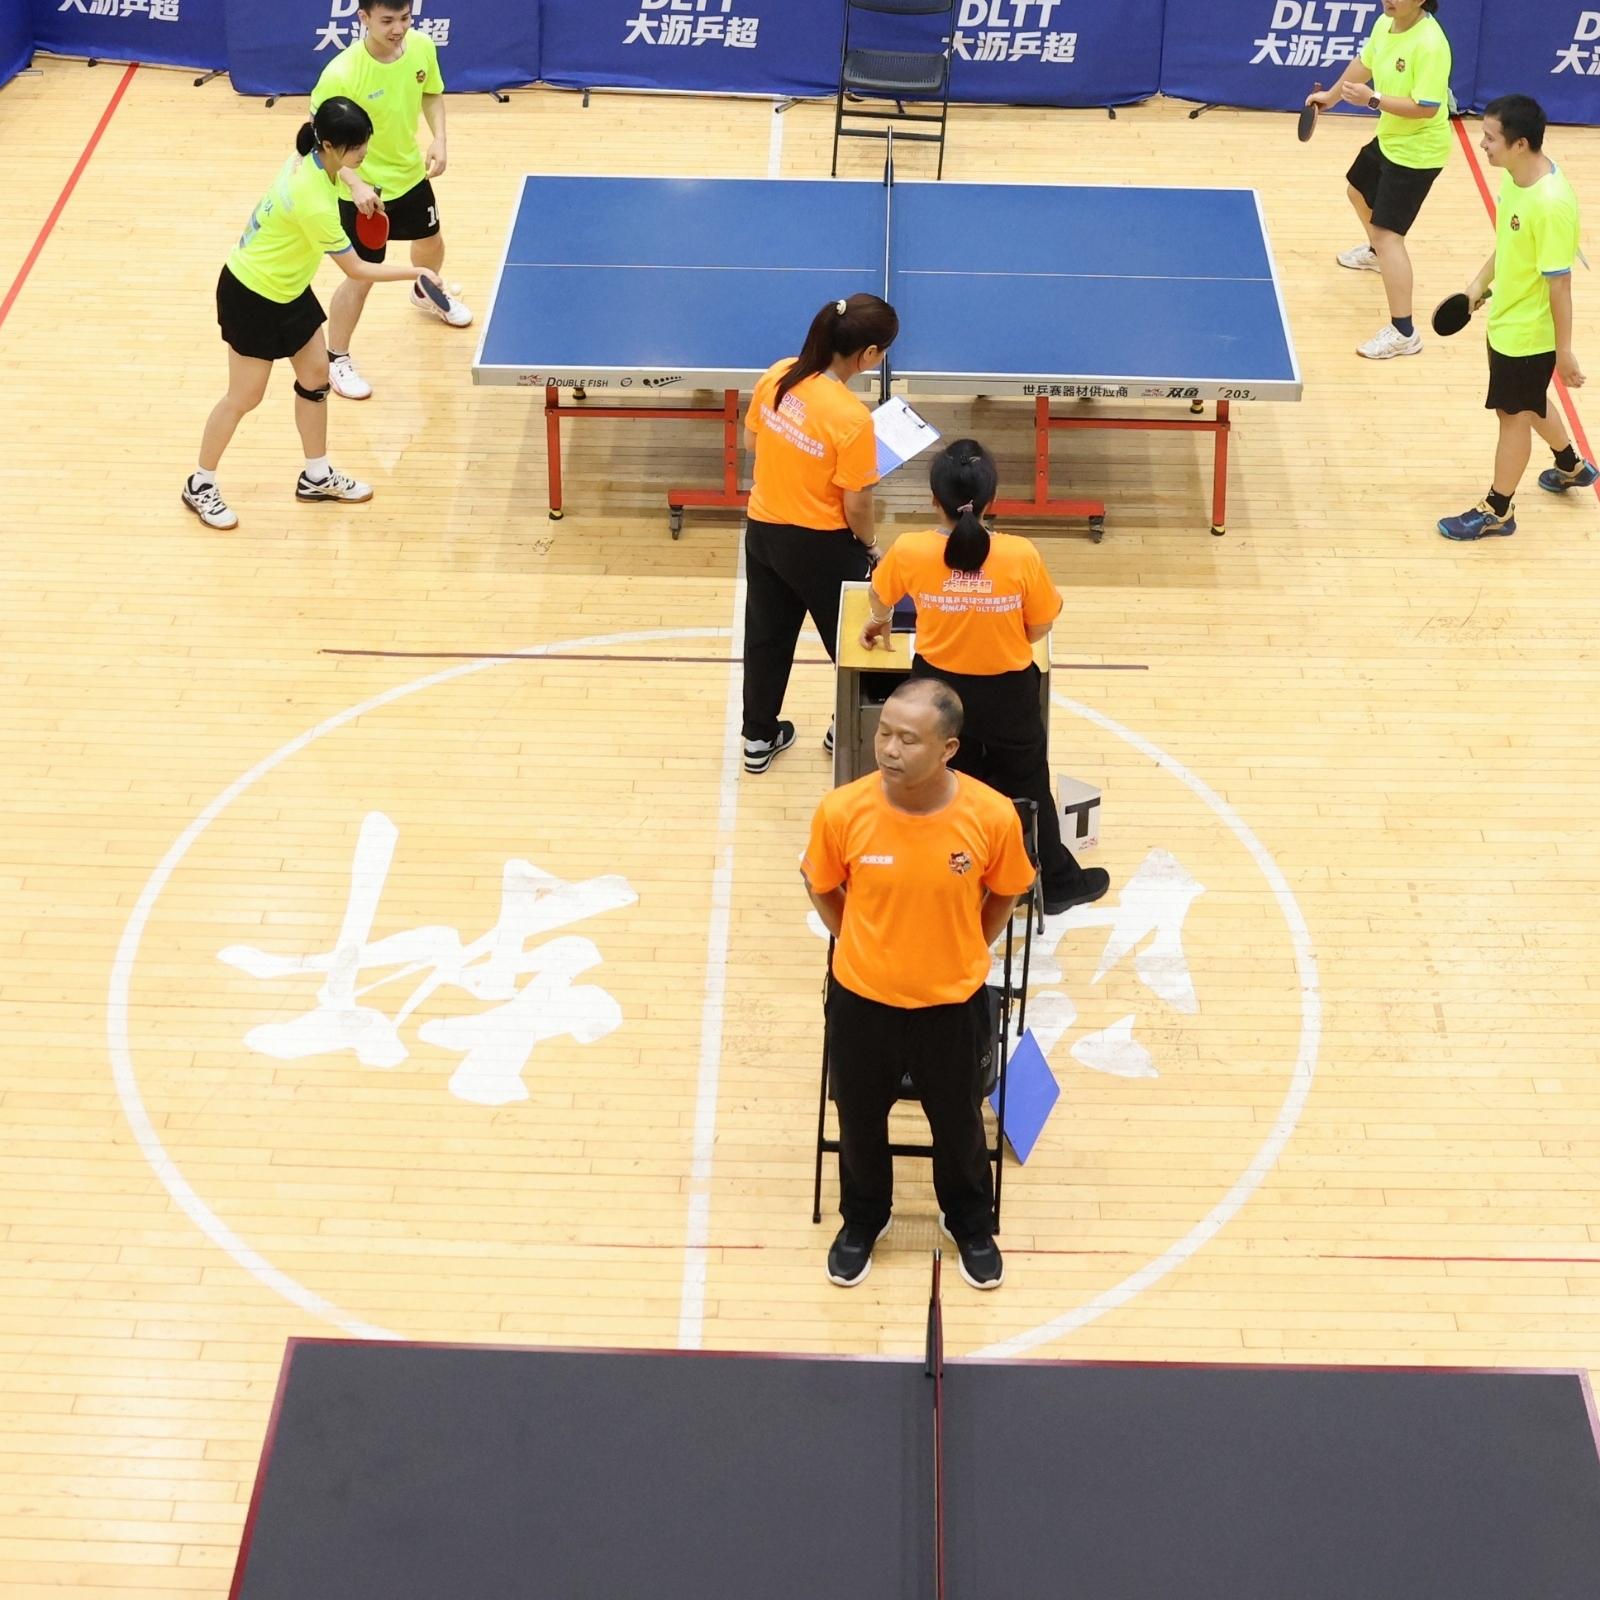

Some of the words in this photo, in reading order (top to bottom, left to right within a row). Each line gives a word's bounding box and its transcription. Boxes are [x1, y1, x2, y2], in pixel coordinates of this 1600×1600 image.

[623, 13, 758, 48] 大沥乒超
[1271, 0, 1376, 32] DLTT
[547, 377, 585, 388] DOUBLE
[588, 378, 609, 388] FISH
[1024, 384, 1128, 398] 世乒赛器材供应商
[1168, 386, 1199, 399] 双鱼
[1065, 797, 1101, 839] T
